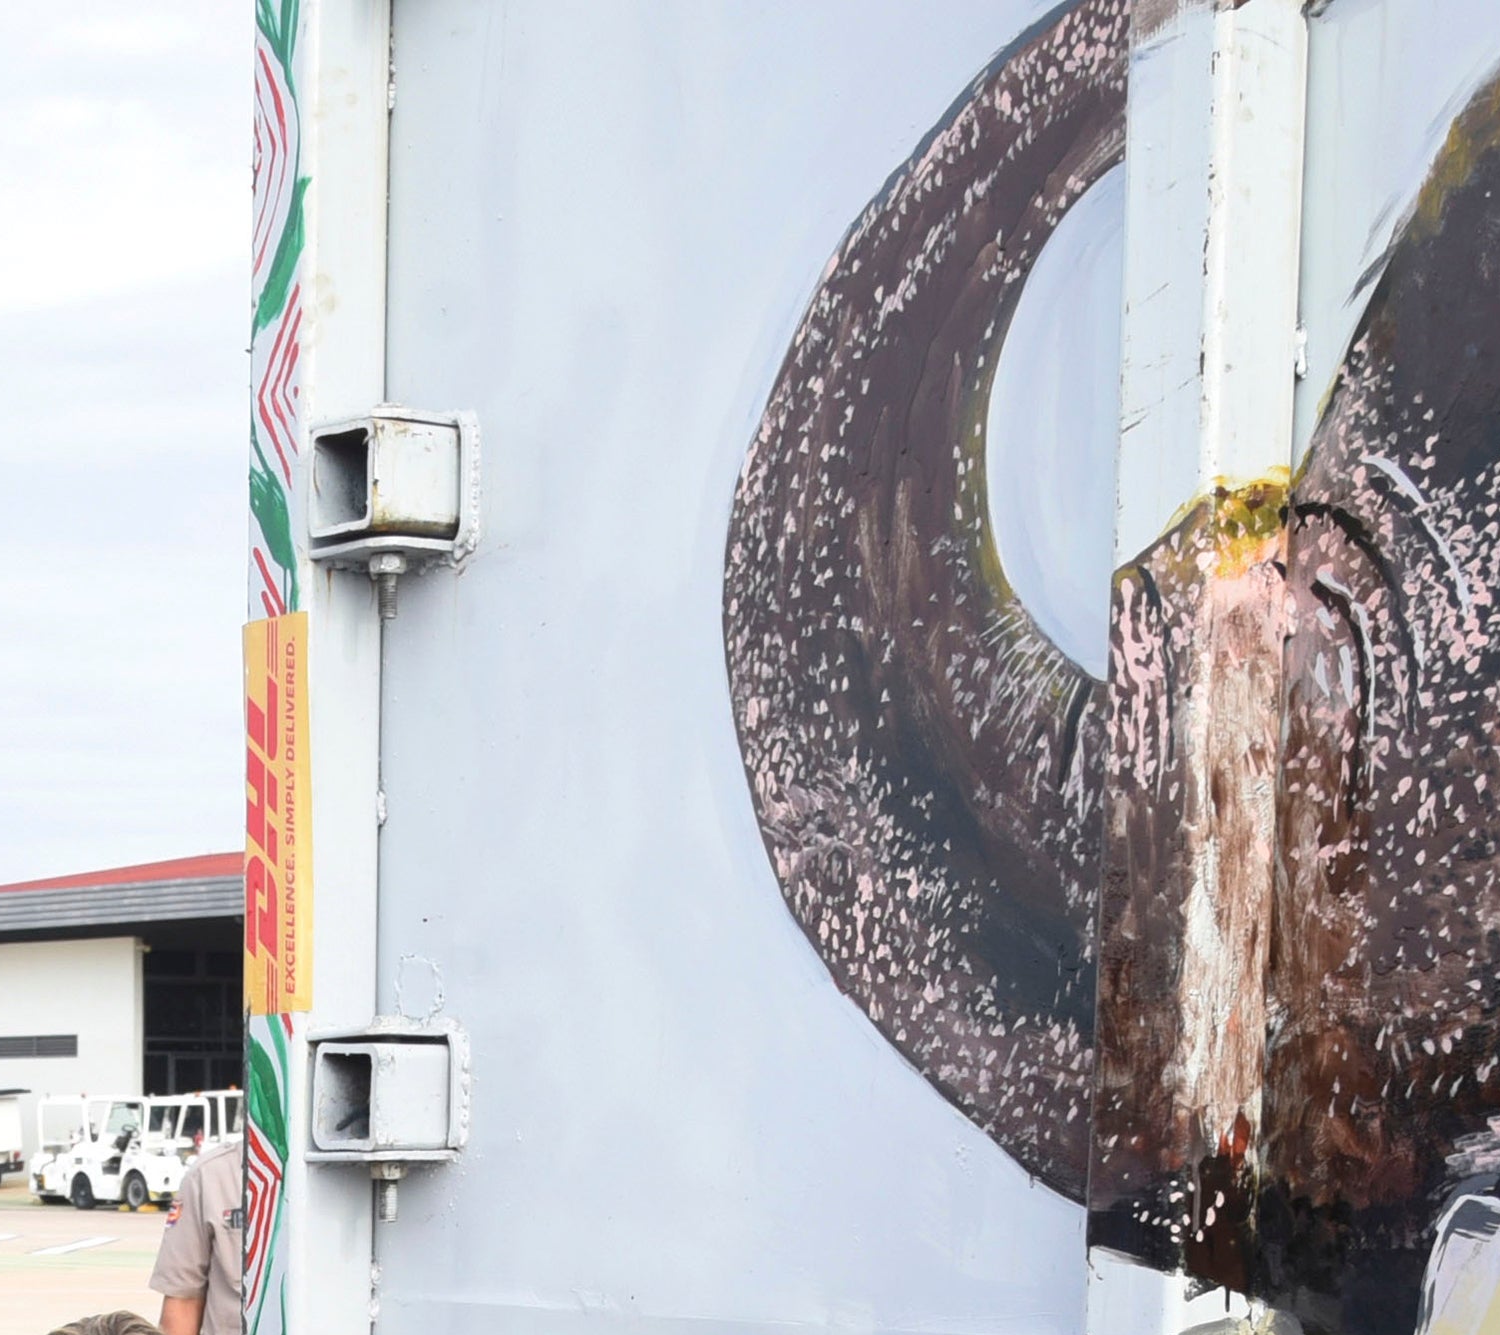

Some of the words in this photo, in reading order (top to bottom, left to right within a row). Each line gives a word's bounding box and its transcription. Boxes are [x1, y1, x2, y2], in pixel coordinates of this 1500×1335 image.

[285, 636, 296, 762] DELIVERED.
[246, 675, 278, 962] DHL
[284, 767, 296, 846] SIMPLY
[284, 853, 296, 994] EXCELLENCE.
